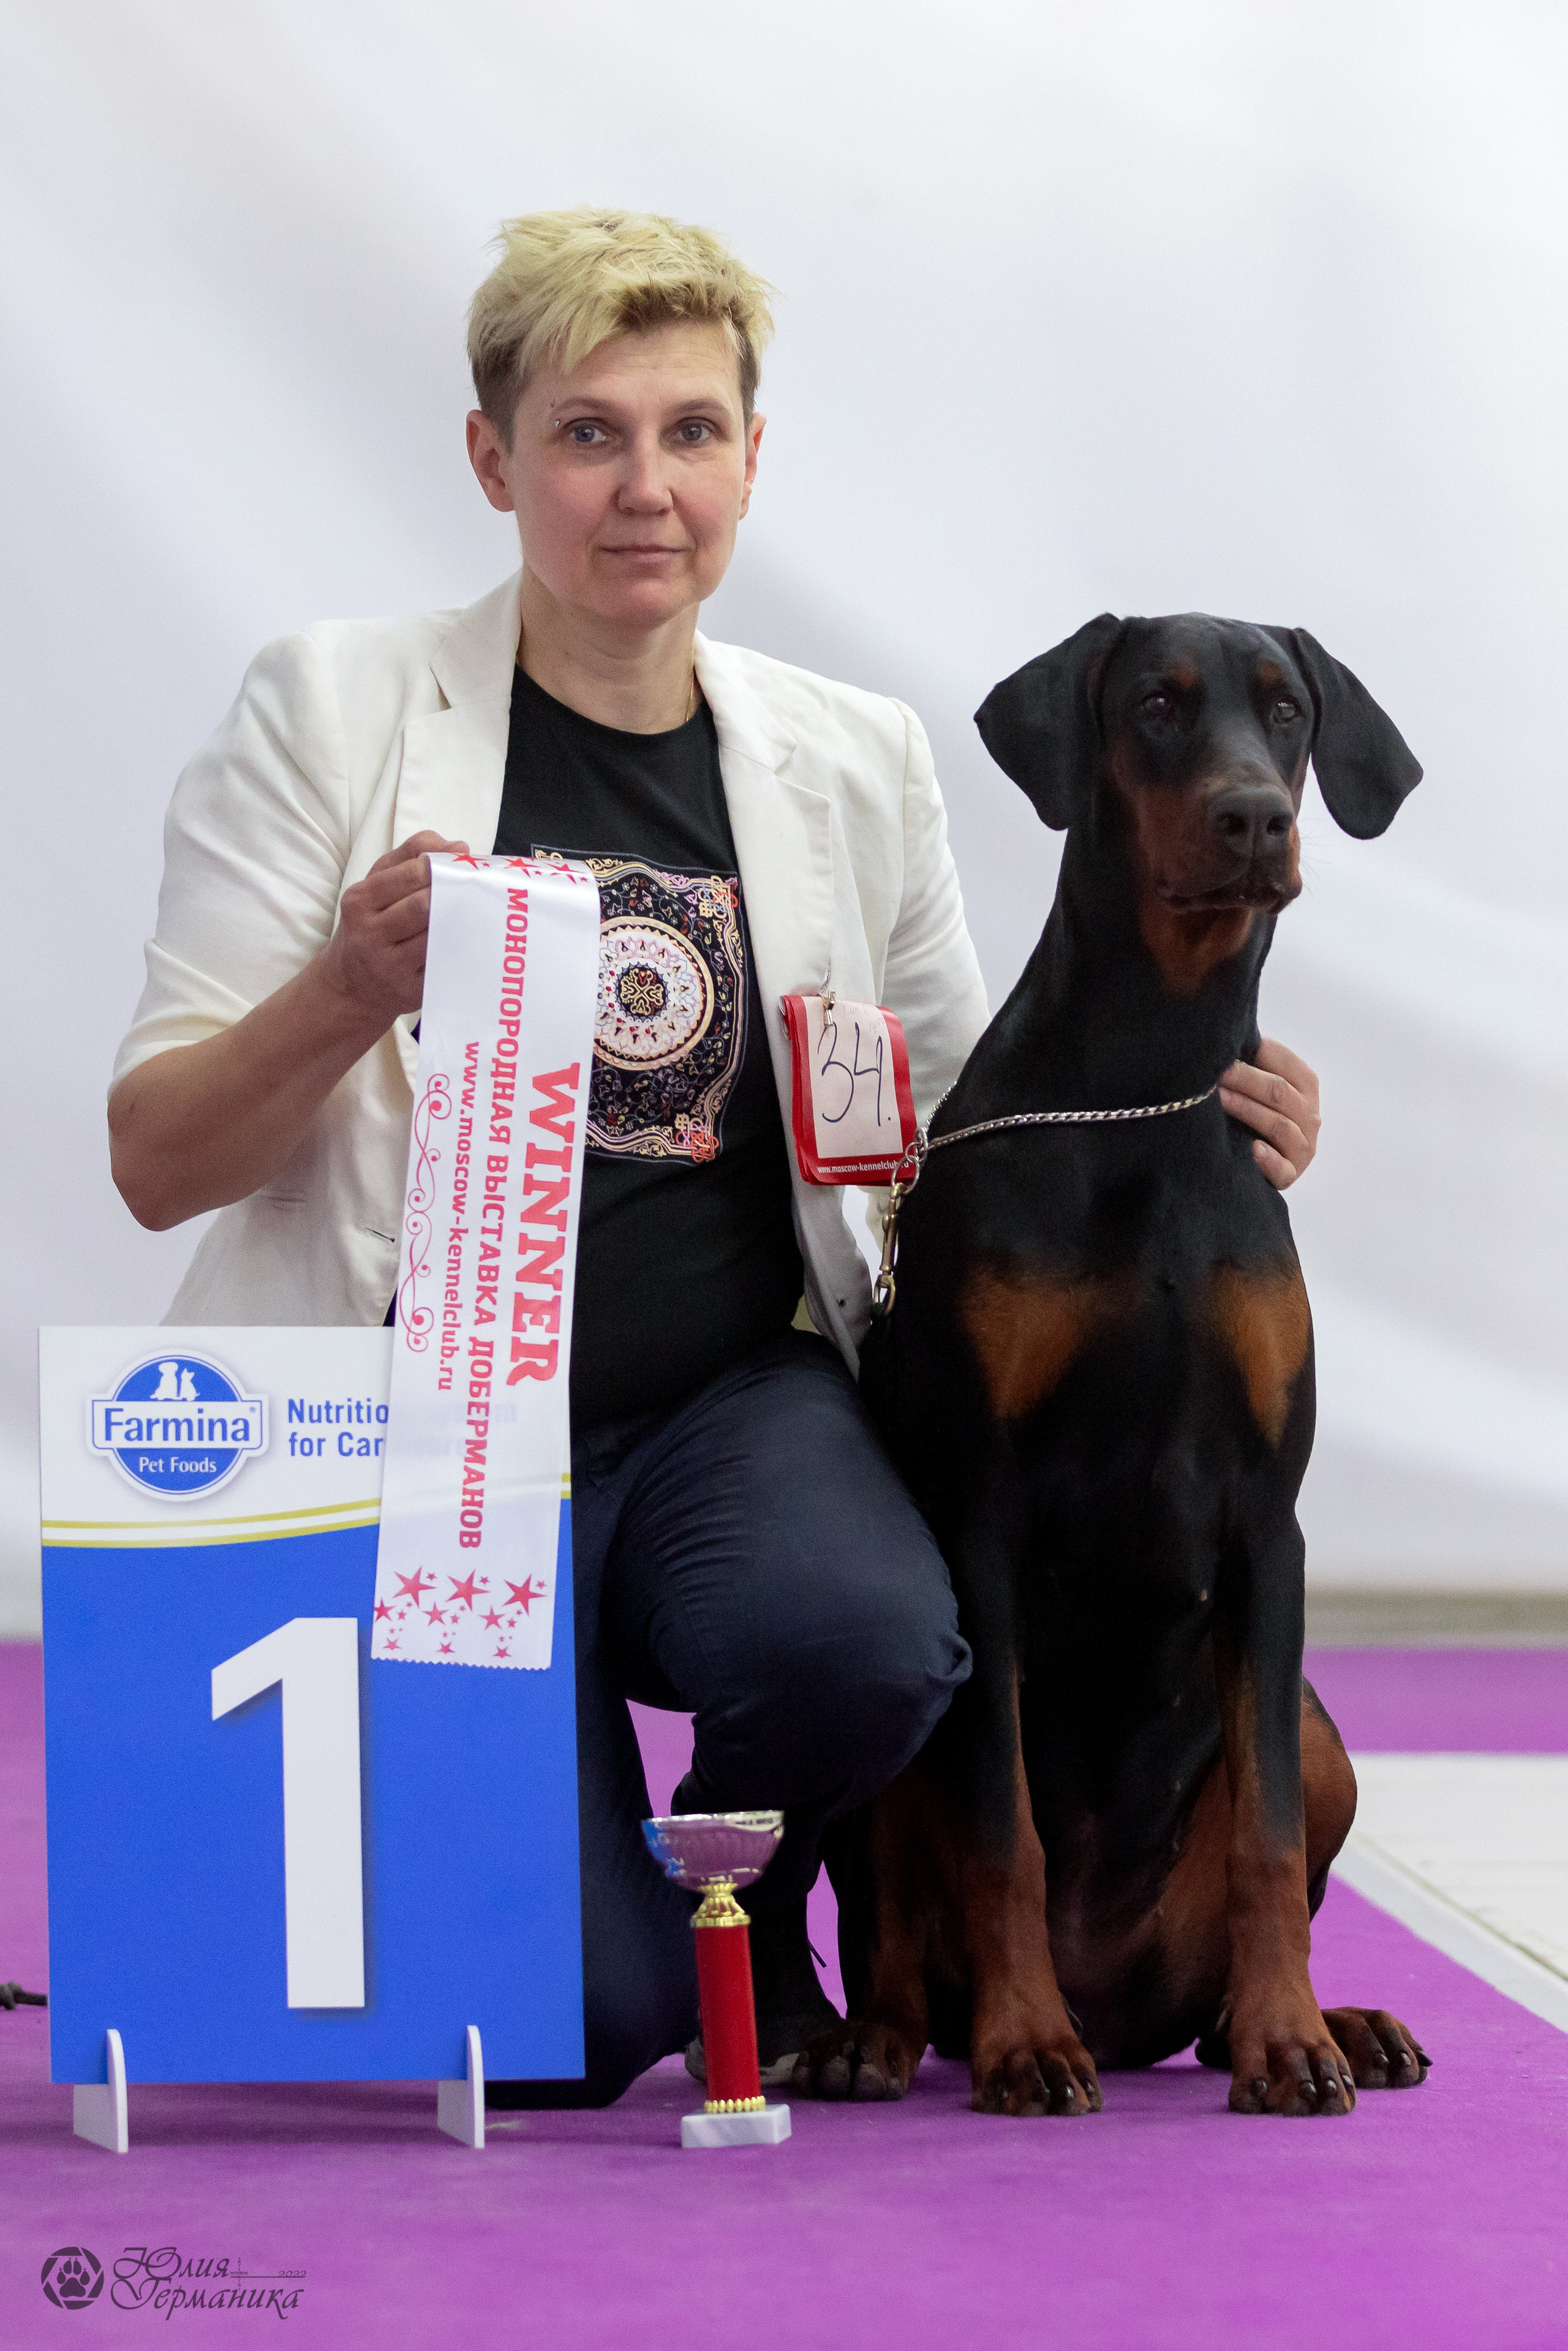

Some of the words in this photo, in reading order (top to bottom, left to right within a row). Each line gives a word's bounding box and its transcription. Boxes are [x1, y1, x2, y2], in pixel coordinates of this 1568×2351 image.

[489, 888, 528, 1144] МОНОПОРОДНАЯ
[437, 1041, 479, 1391] www.moscow-kennelclub.ru
[473, 1155, 508, 1326] ВЫСТАВКА
[506, 1061, 580, 1386] WINNER
[104, 1407, 251, 1442] Farmina
[138, 1457, 164, 1473] Pet
[170, 1456, 217, 1473] Foods
[287, 1398, 390, 1424] Nutritio
[288, 1431, 326, 1457] for
[459, 1336, 494, 1549] ДОБЕРМАНОВ
[211, 1617, 365, 2009] 1
